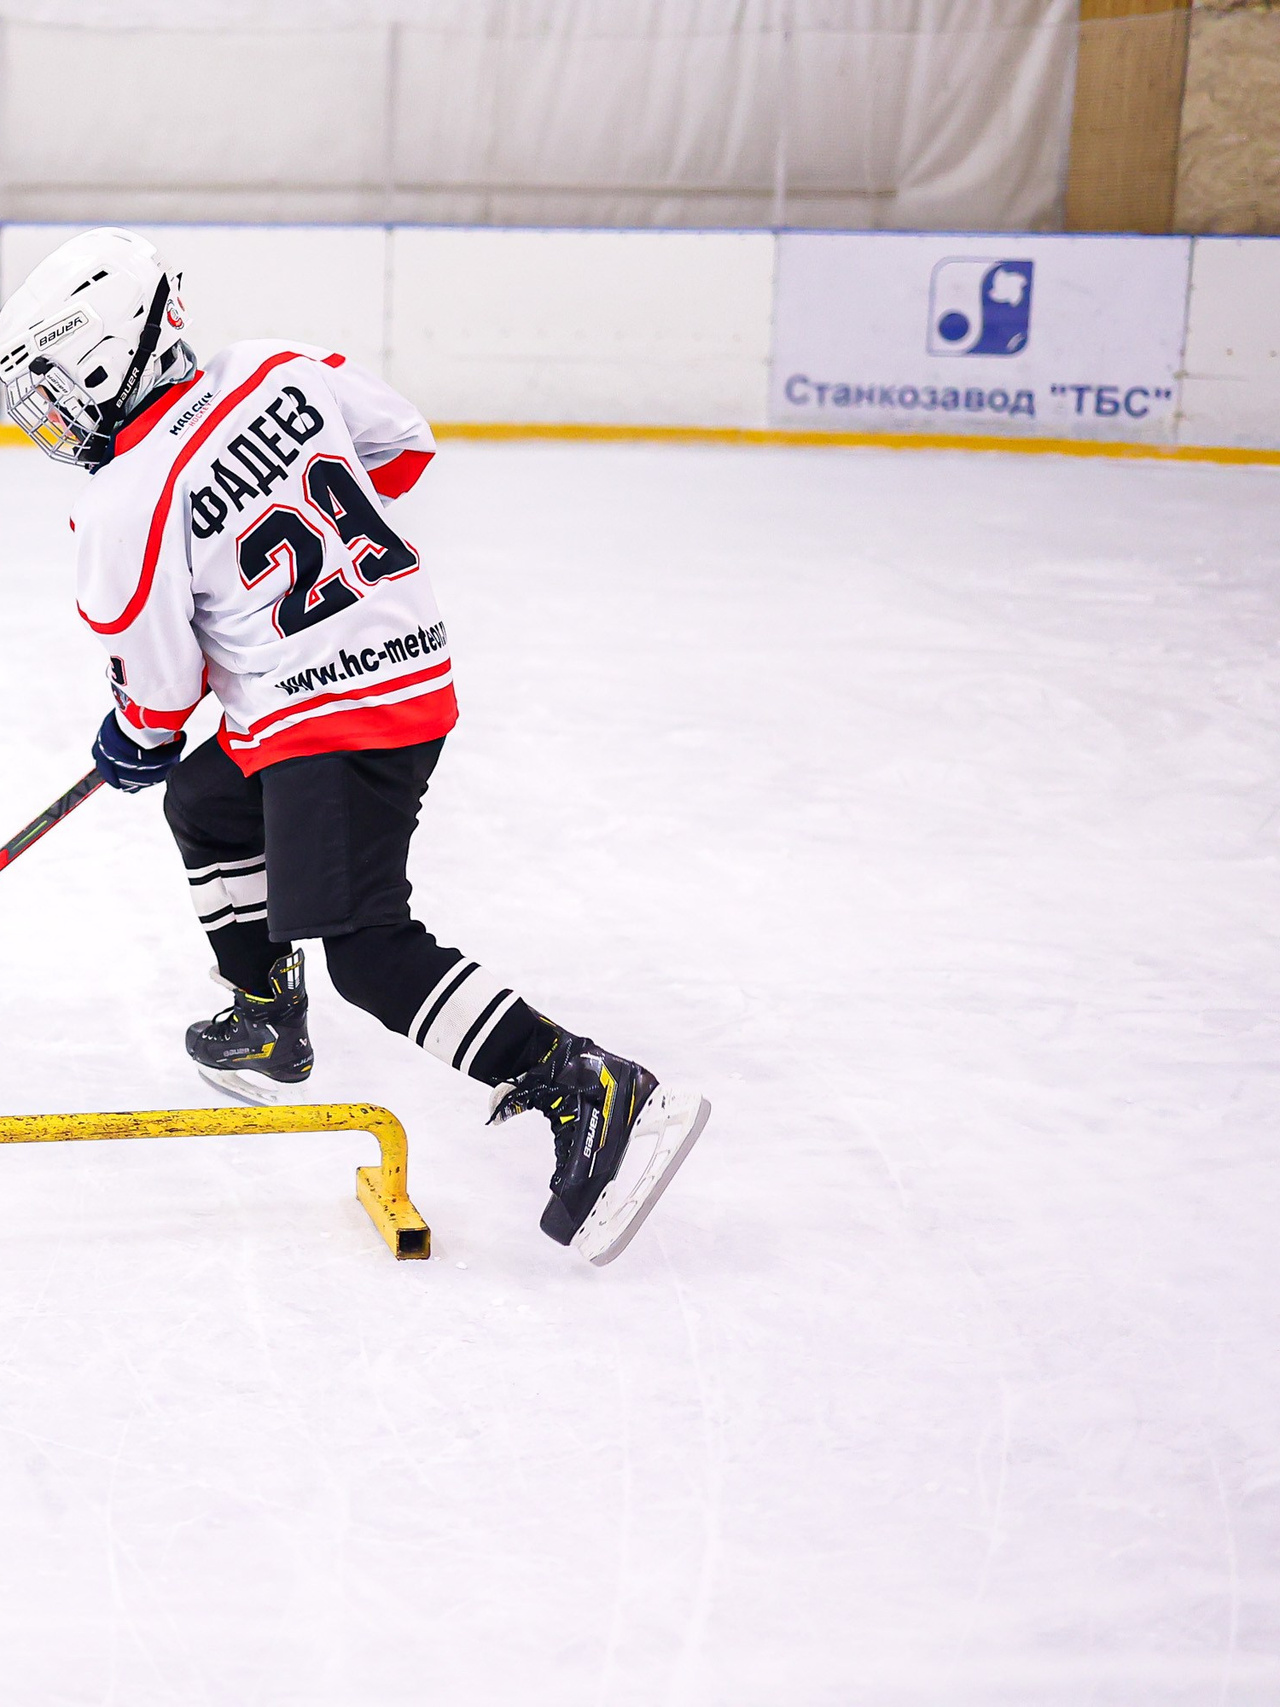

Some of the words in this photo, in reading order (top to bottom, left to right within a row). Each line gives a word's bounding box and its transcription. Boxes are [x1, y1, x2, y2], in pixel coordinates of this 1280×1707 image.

[784, 374, 1037, 418] Станкозавод
[1050, 382, 1172, 418] "ТБС"
[169, 410, 194, 436] MAD
[190, 402, 212, 427] HOCKEY
